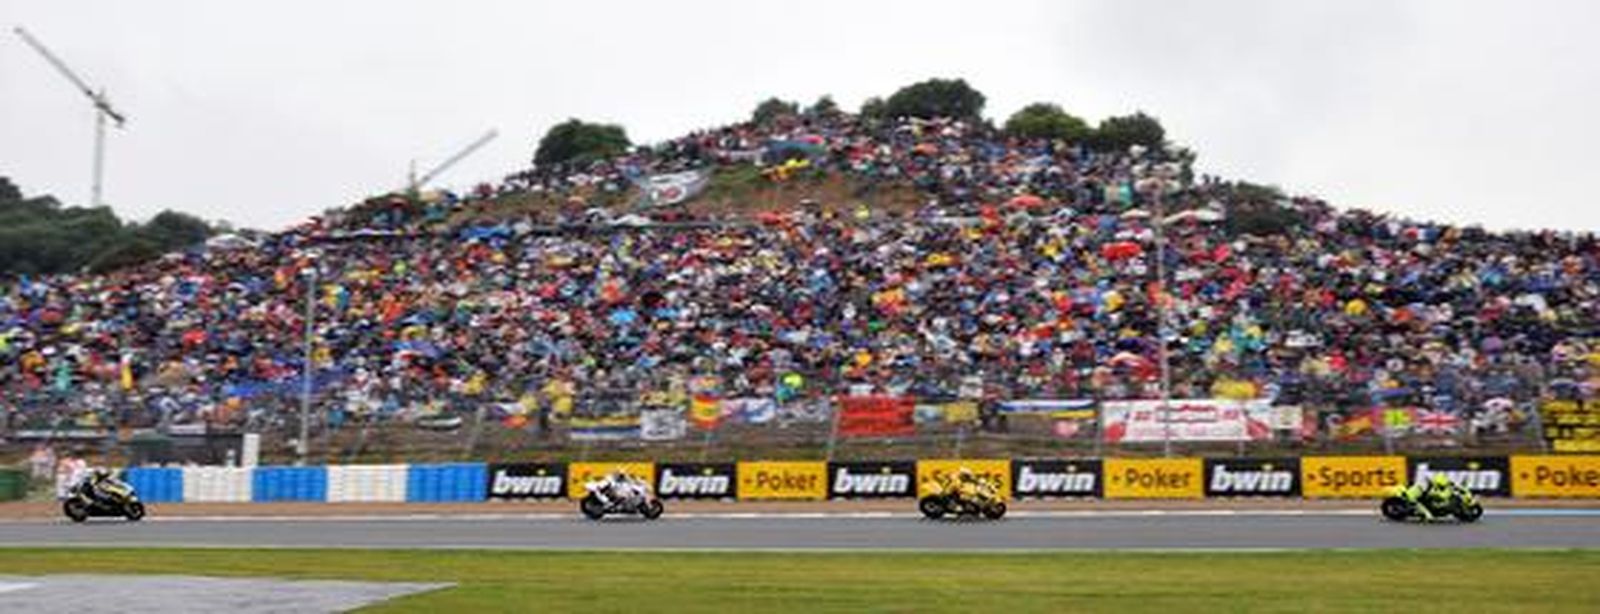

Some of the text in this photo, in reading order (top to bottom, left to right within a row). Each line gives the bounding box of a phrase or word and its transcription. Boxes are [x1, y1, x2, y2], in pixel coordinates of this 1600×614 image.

[492, 470, 562, 494] bwin
[659, 468, 729, 494] bwin
[756, 471, 817, 490] Poker
[833, 466, 910, 493] bwin
[1016, 465, 1096, 492] bwin
[1126, 468, 1192, 488] Poker
[1210, 464, 1293, 492] bwin
[1320, 466, 1398, 488] Sports
[1535, 465, 1600, 487] Poke
